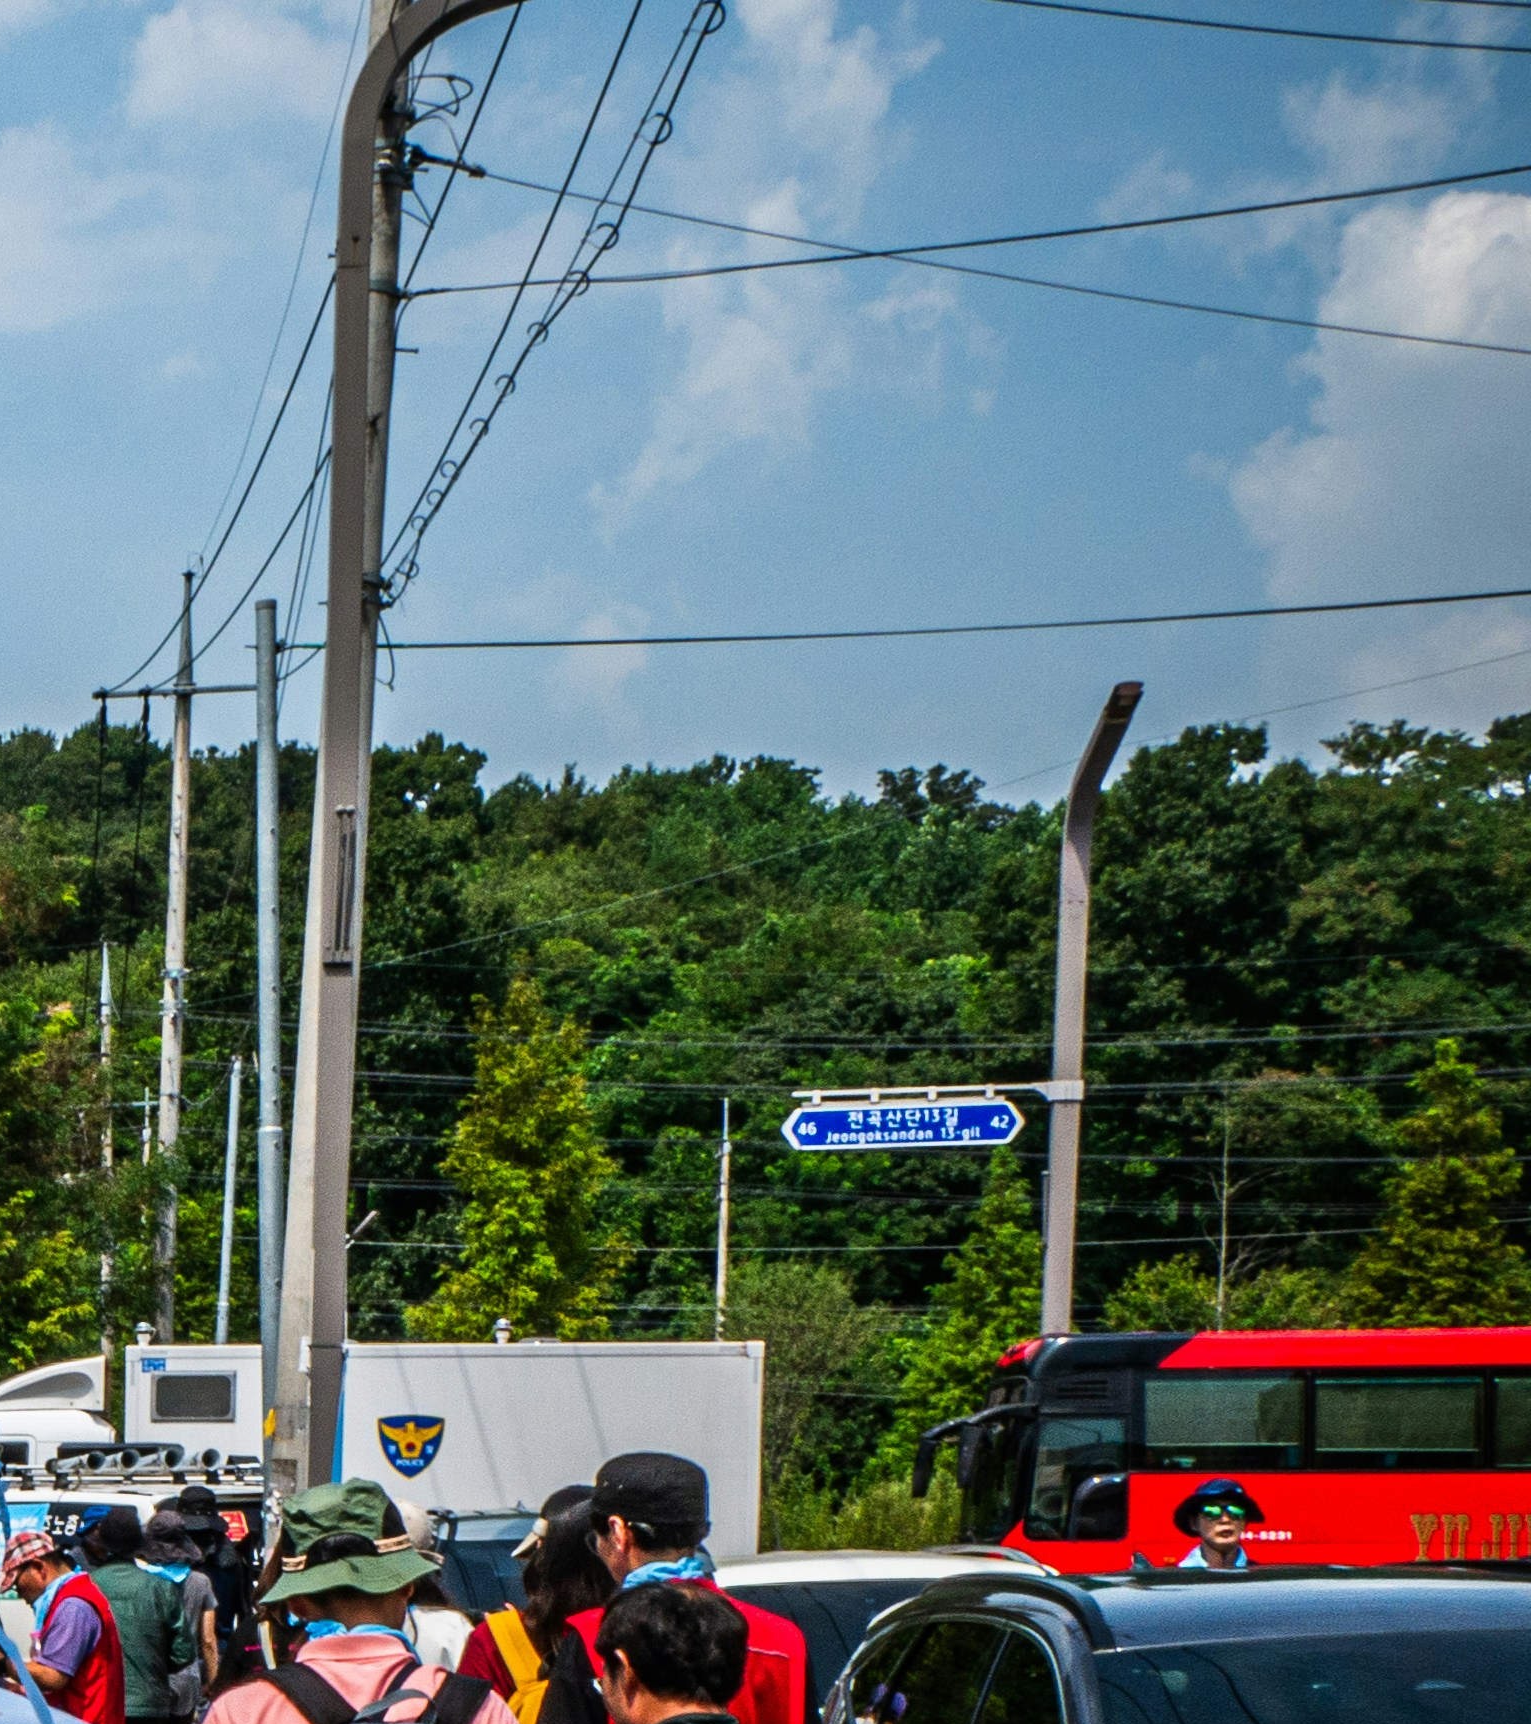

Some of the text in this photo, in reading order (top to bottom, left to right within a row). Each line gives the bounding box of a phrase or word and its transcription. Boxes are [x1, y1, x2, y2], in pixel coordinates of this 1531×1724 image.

[847, 1108, 959, 1130] 전곡산단13길
[990, 1115, 1010, 1130] 42
[796, 1121, 817, 1137] 46
[825, 1125, 981, 1145] Jeongoksandan 13-gil
[395, 1458, 425, 1467] POLICE
